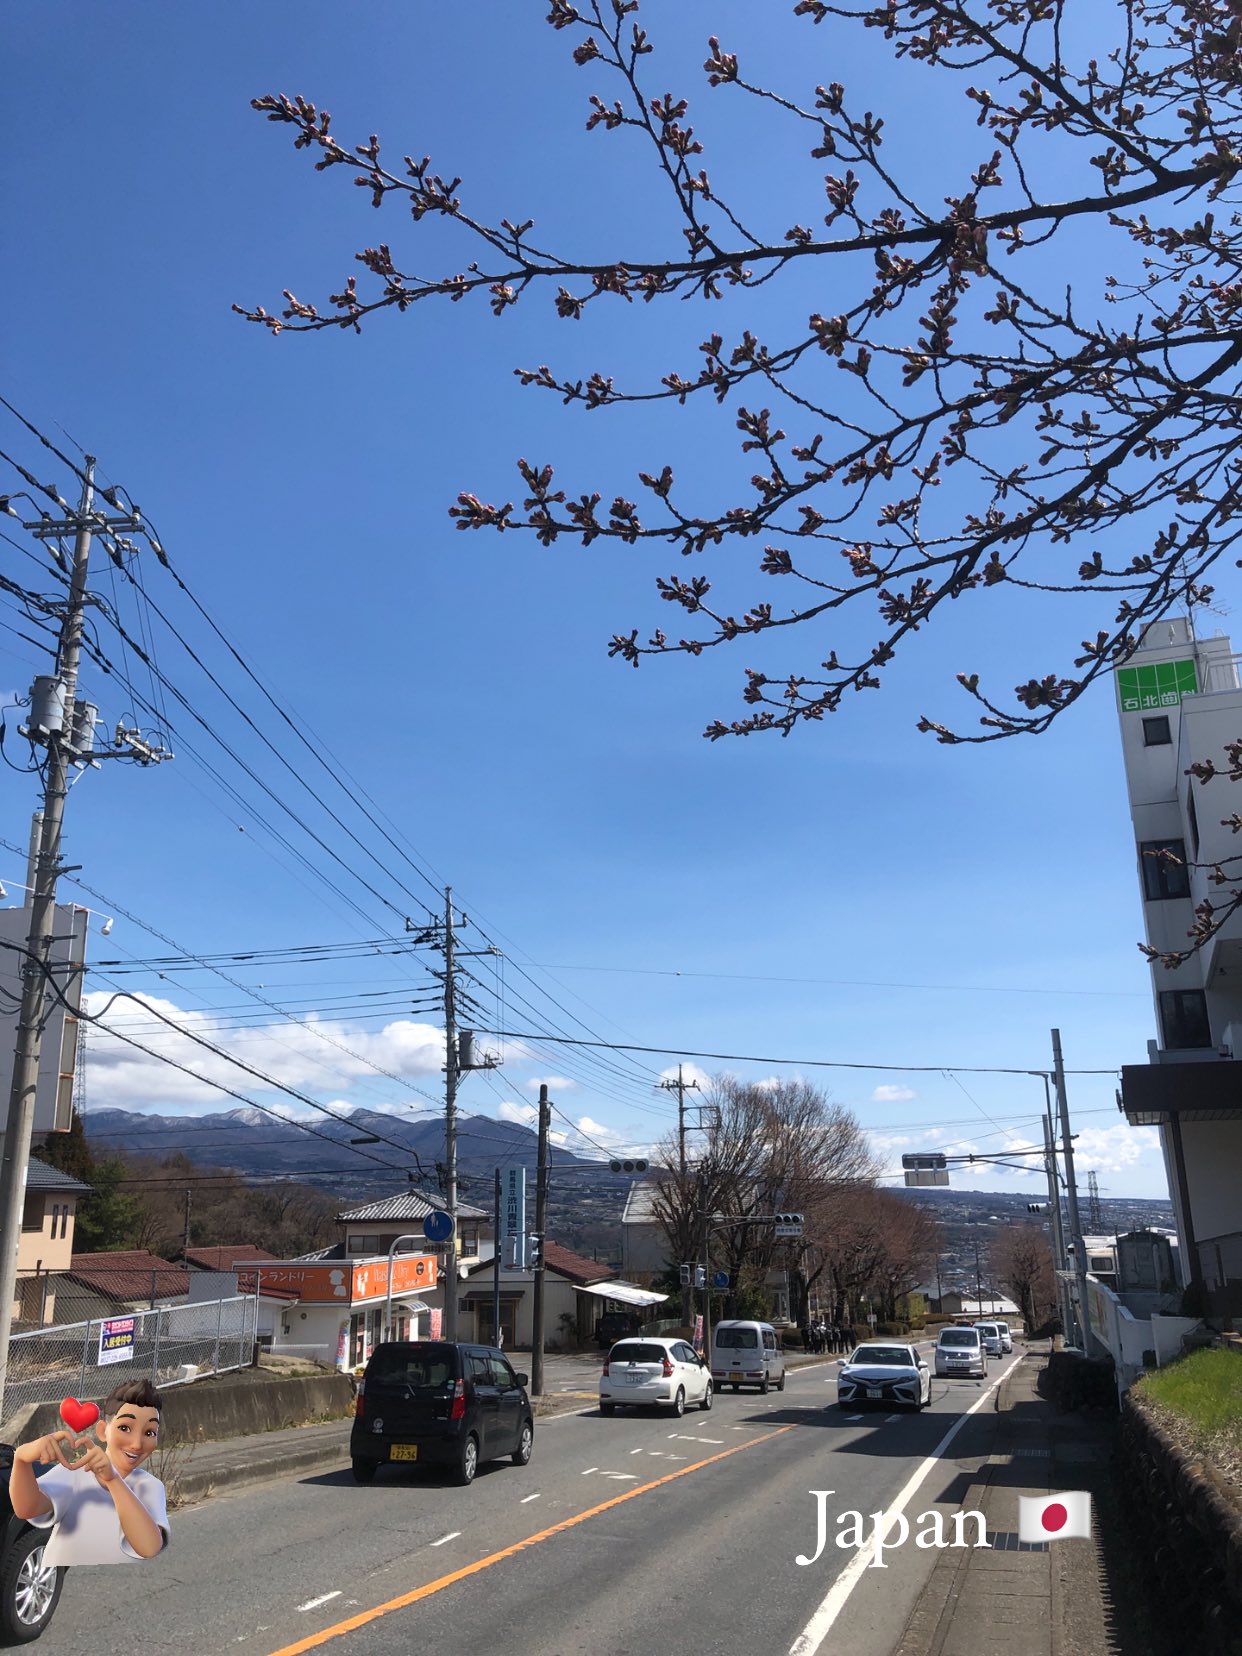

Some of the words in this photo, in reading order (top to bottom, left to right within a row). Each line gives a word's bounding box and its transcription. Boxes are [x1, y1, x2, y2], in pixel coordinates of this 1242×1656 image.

[240, 1271, 315, 1283] コインランドリー
